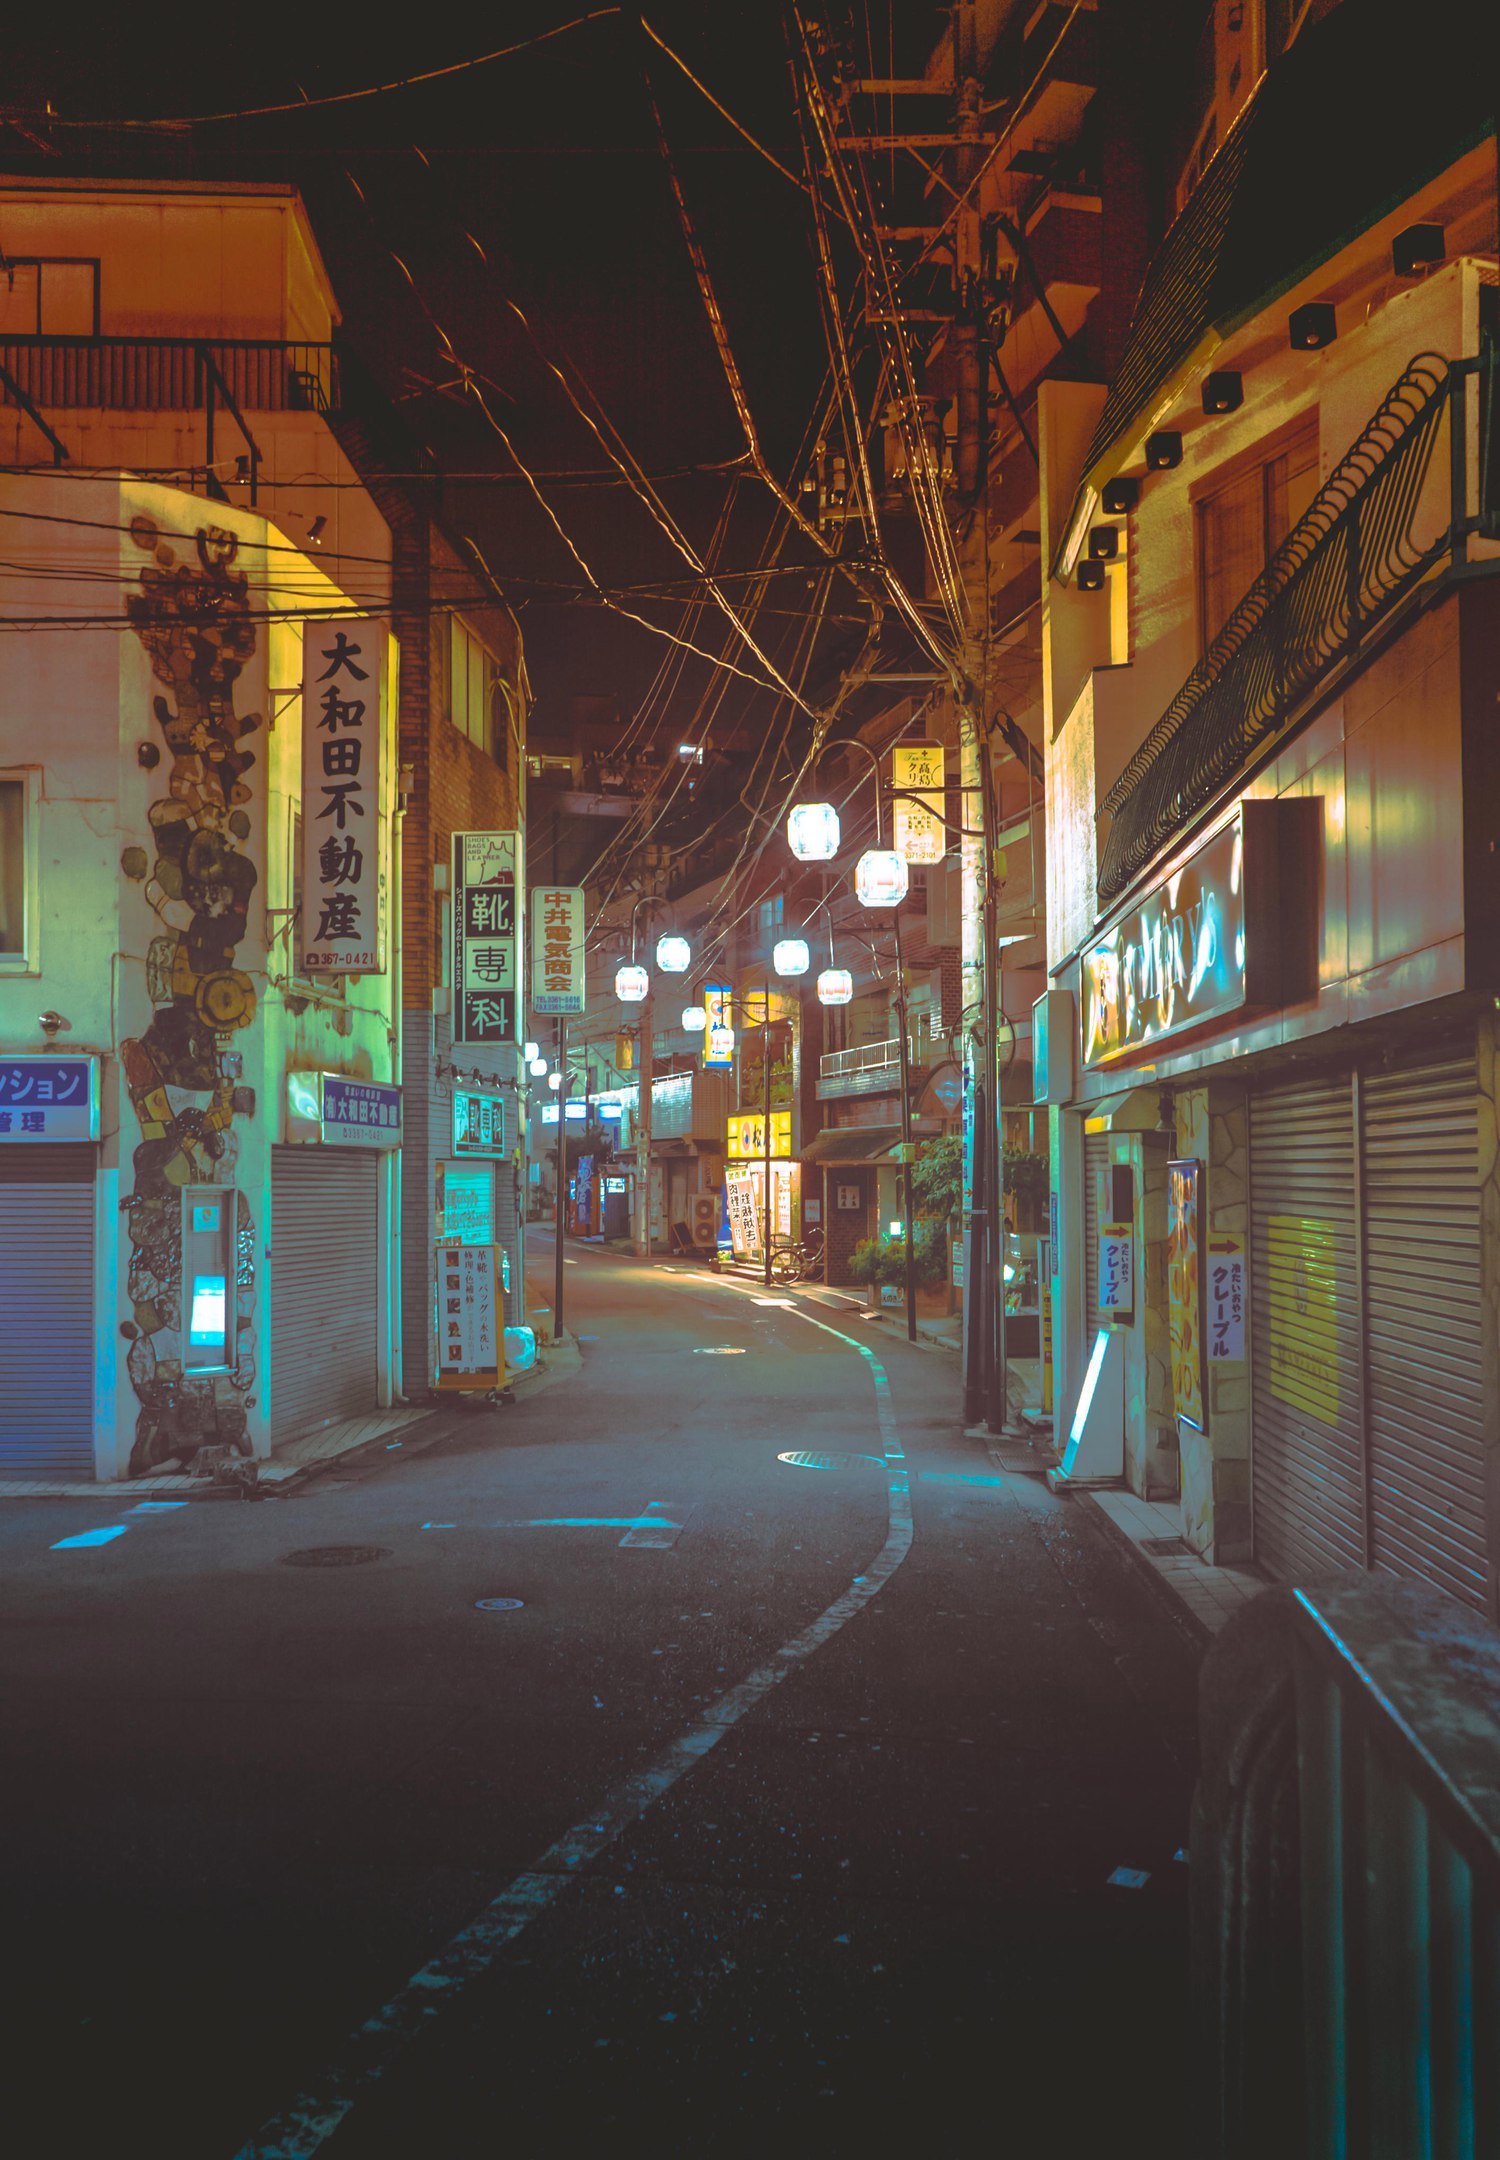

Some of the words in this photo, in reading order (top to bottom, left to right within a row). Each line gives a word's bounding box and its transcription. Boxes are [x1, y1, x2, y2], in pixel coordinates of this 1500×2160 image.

[314, 631, 371, 942] 大和田不動産
[321, 952, 374, 965] 367-0421
[471, 893, 508, 1036] 靴専科
[543, 891, 572, 992] 中井電気商会
[1231, 1263, 1242, 1323] 冷たいおやつ
